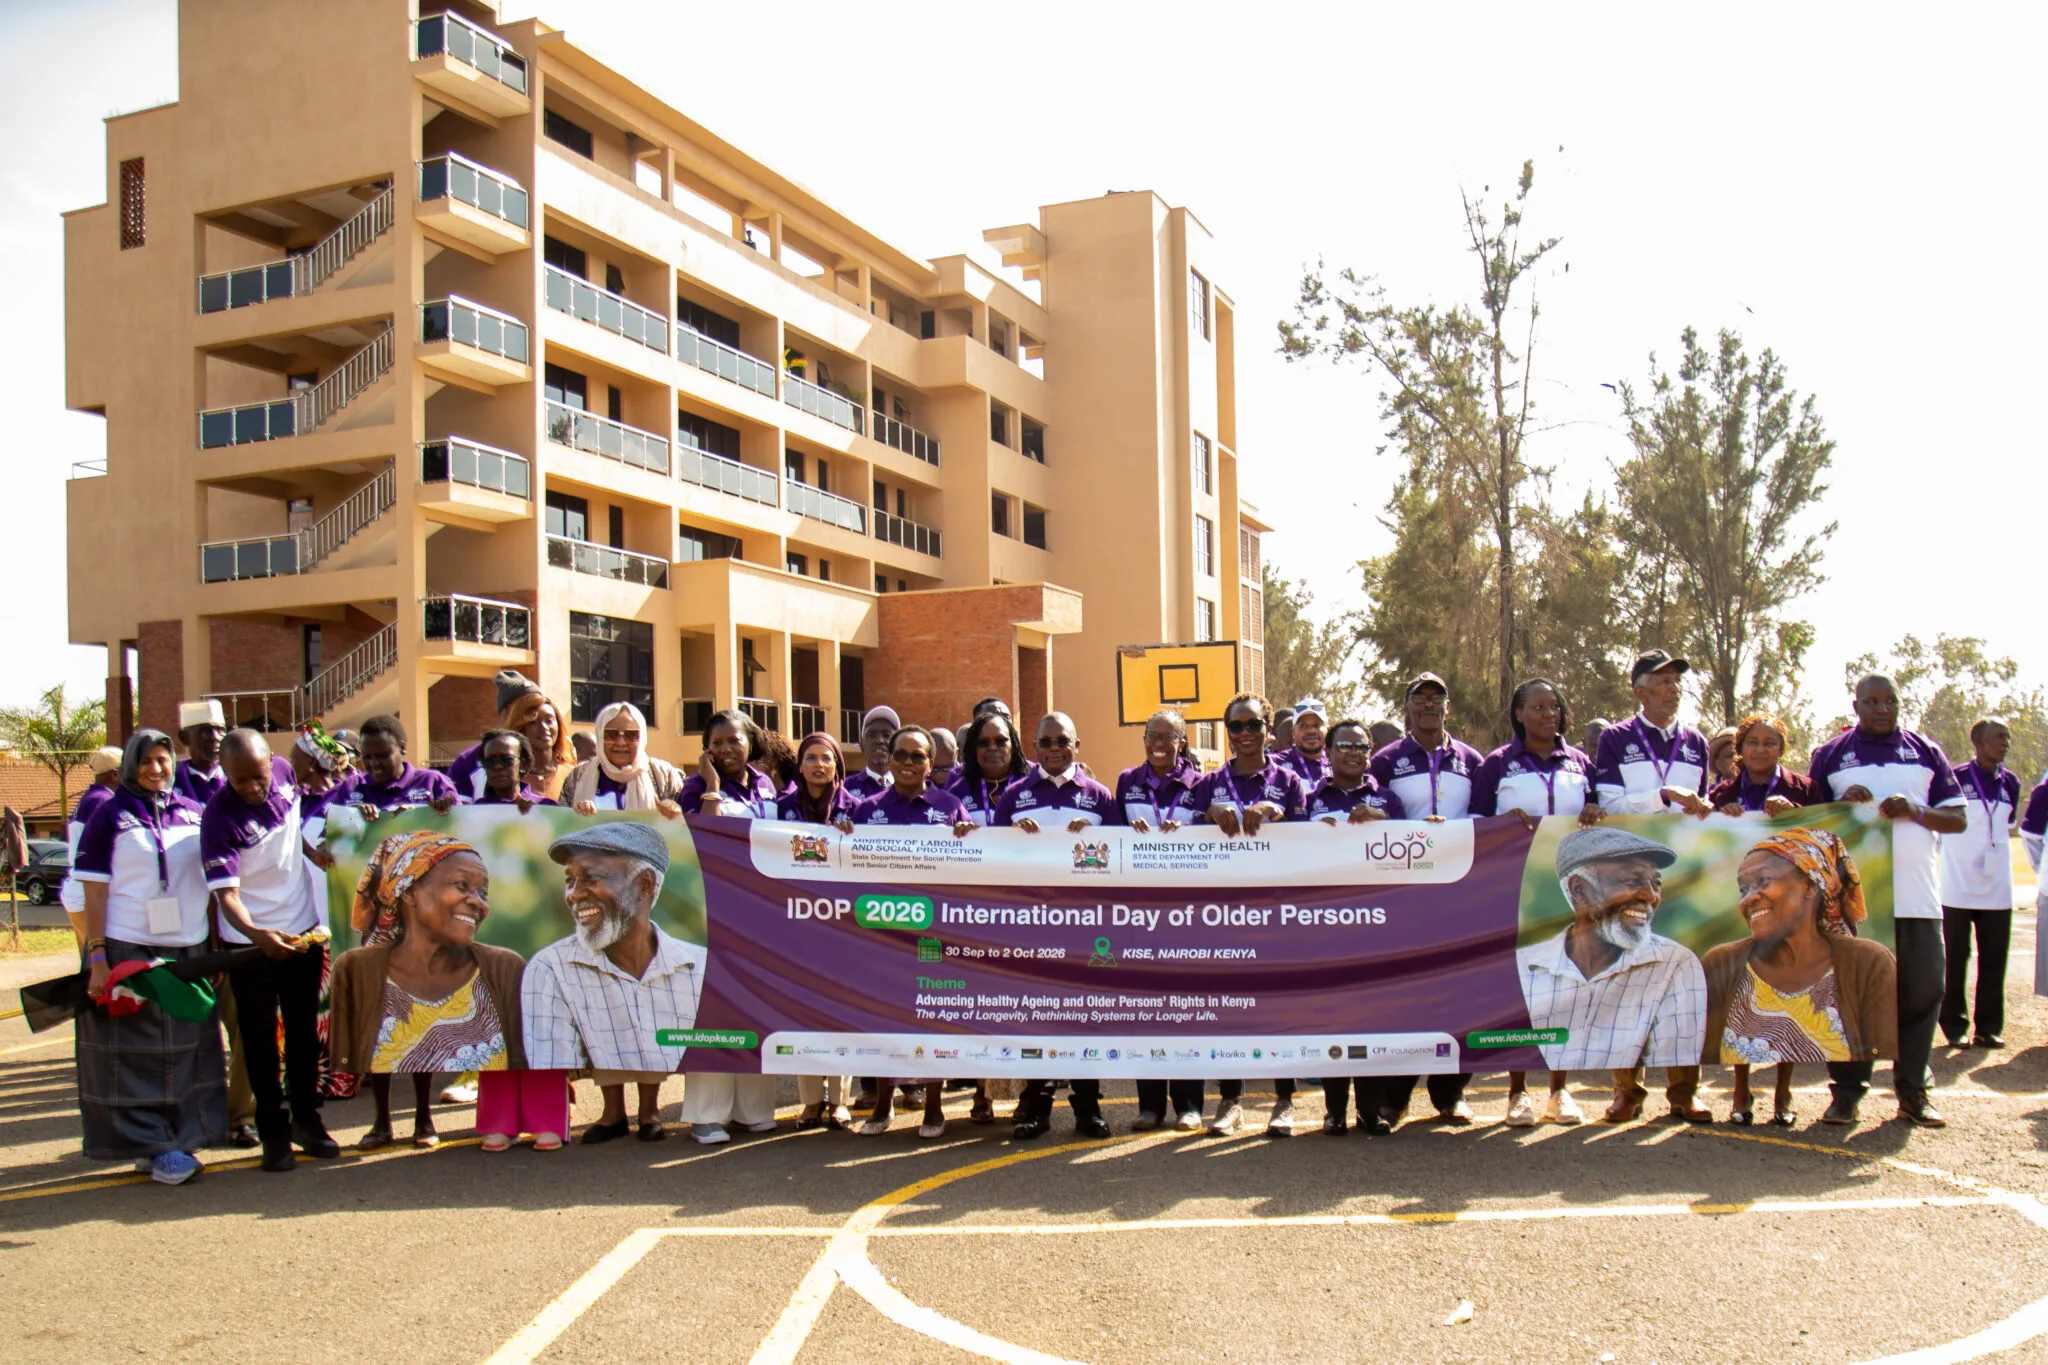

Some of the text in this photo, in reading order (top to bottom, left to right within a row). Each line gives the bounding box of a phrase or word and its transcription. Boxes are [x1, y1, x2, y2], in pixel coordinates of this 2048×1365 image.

[852, 837, 902, 846] MINISTRY
[920, 840, 963, 848] LABOUR
[1132, 841, 1271, 852] MINISTRY OF HEALTH
[851, 843, 983, 855] AND SOCIAL PROTECTION
[851, 853, 869, 861] State
[871, 855, 911, 863] Department
[923, 855, 945, 863] Social
[1132, 853, 1231, 861] STATE DEPARTMENT FOR
[1132, 862, 1209, 870] MEDICAL SERVICES
[786, 897, 1387, 932] IDOP 2026 International Day of Older Persons
[945, 946, 1066, 959] 30 Sep to 2 Oct 2026
[1122, 948, 1257, 960] KISE, NAIROBI KENYA
[916, 976, 967, 990] Theme
[915, 993, 974, 1009] Advancing
[977, 994, 1019, 1009] Healthy
[1021, 995, 1060, 1010] Ageing
[1063, 995, 1084, 1008] and
[1087, 995, 1117, 1008] Older
[1169, 995, 1206, 1010] Rights
[1208, 995, 1219, 1008] in
[1221, 995, 1257, 1010] Kenya
[915, 1008, 1219, 1023] The Age of Longevity, Rethinking Systems for Longer Life.
[667, 1032, 746, 1046] www.idopke.org
[1479, 1031, 1557, 1045] www.idopke.org
[1372, 1046, 1435, 1056] CPF FOUNDATION
